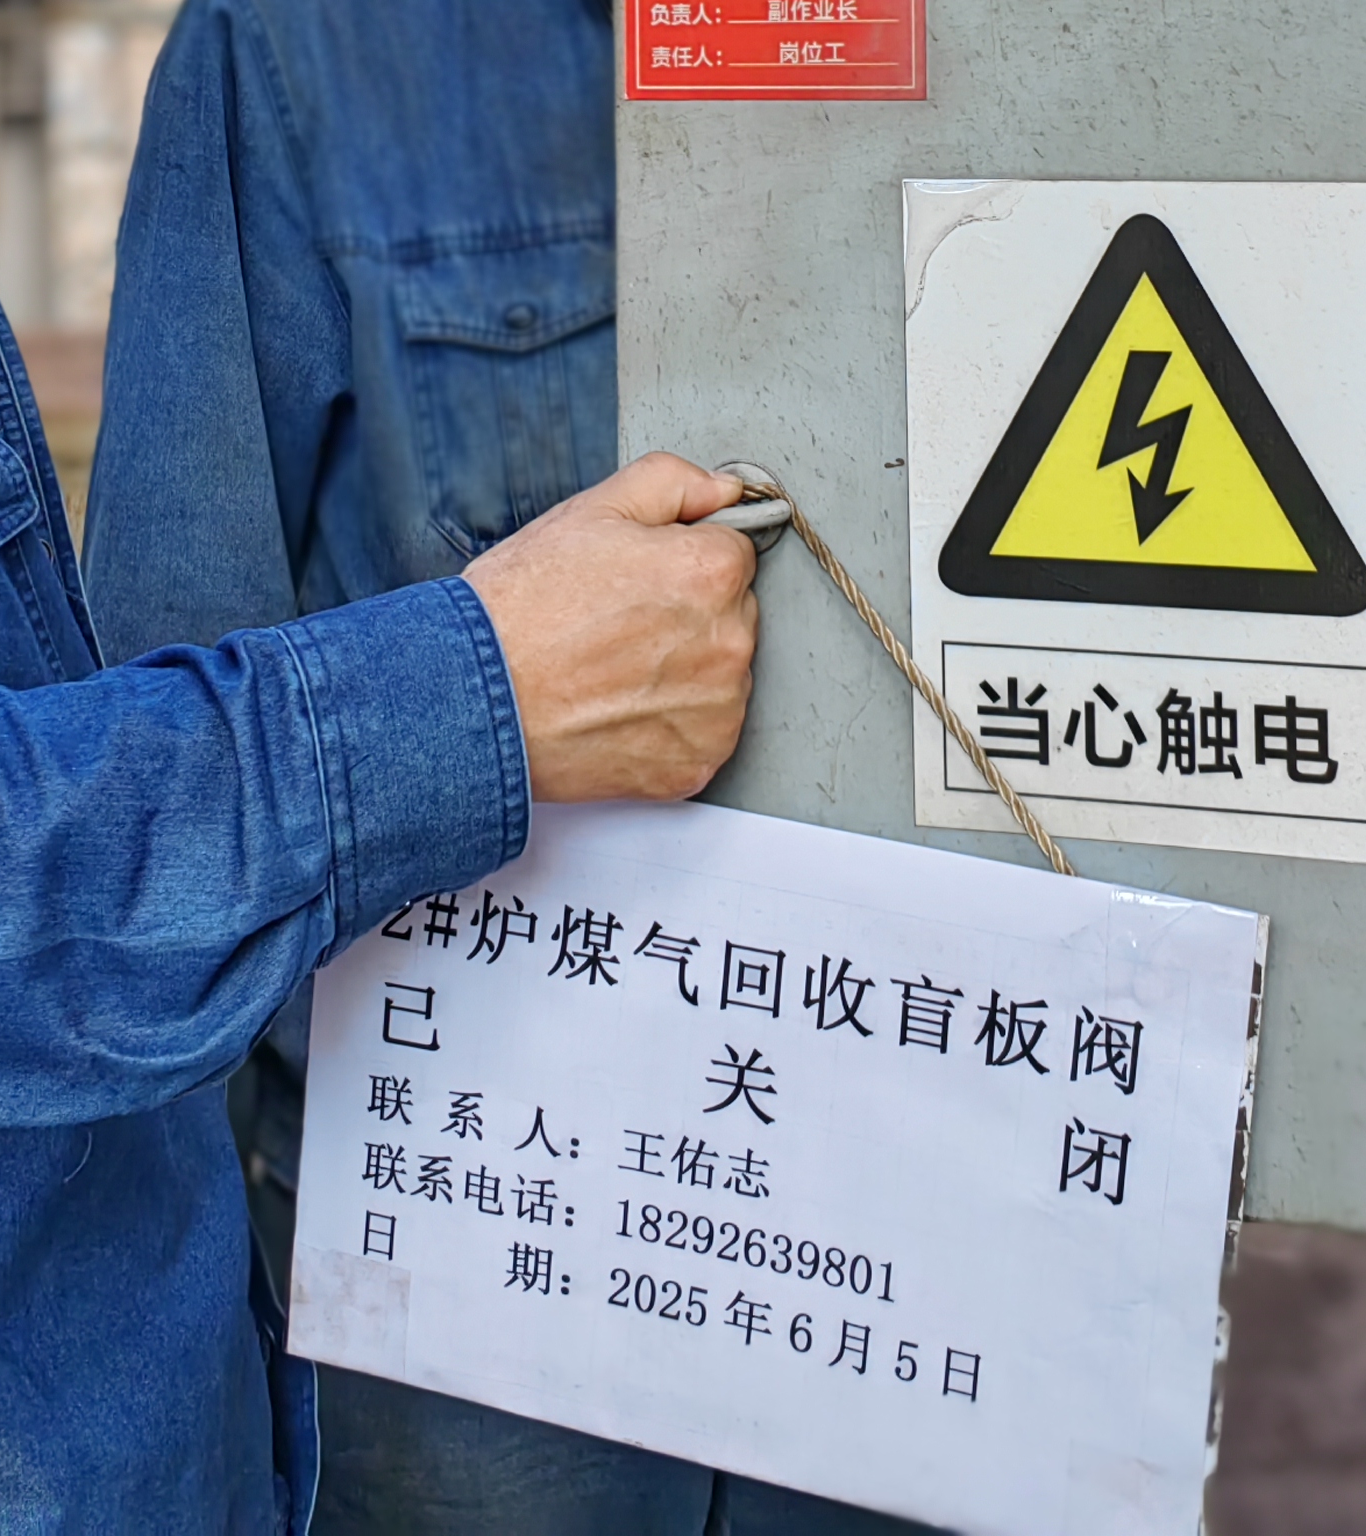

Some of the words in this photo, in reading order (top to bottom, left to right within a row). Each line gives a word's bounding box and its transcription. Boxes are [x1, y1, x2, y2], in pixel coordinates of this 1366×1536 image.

[650, 3, 721, 26] 负责人：
[651, 46, 722, 68] 责任人：
[778, 41, 849, 64] 岗位工
[977, 676, 1338, 784] 当心触电
[617, 1129, 770, 1198] 王佑志
[361, 1142, 575, 1227] 联系电话：
[616, 1199, 895, 1303] 18292639801
